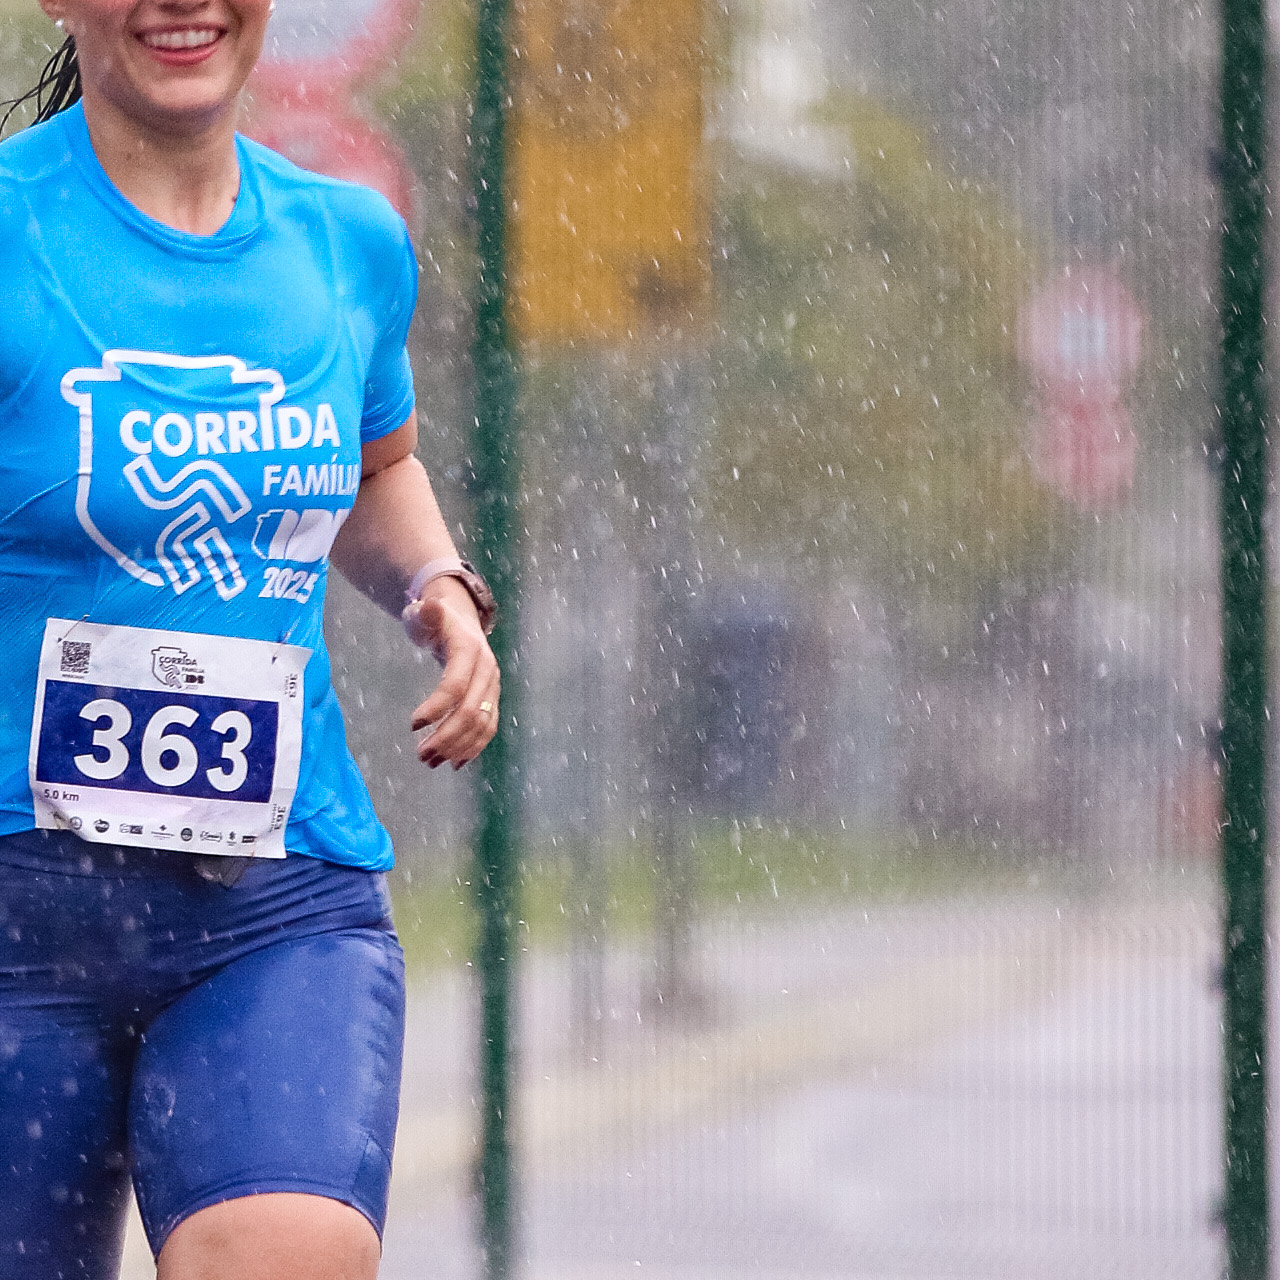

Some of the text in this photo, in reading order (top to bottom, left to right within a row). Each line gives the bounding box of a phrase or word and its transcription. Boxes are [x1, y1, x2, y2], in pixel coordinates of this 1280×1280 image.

[119, 403, 342, 457] CORRIDA
[257, 566, 320, 605] 2025
[289, 672, 299, 699] 363
[72, 698, 253, 794] 363
[43, 788, 80, 802] 5.0 km
